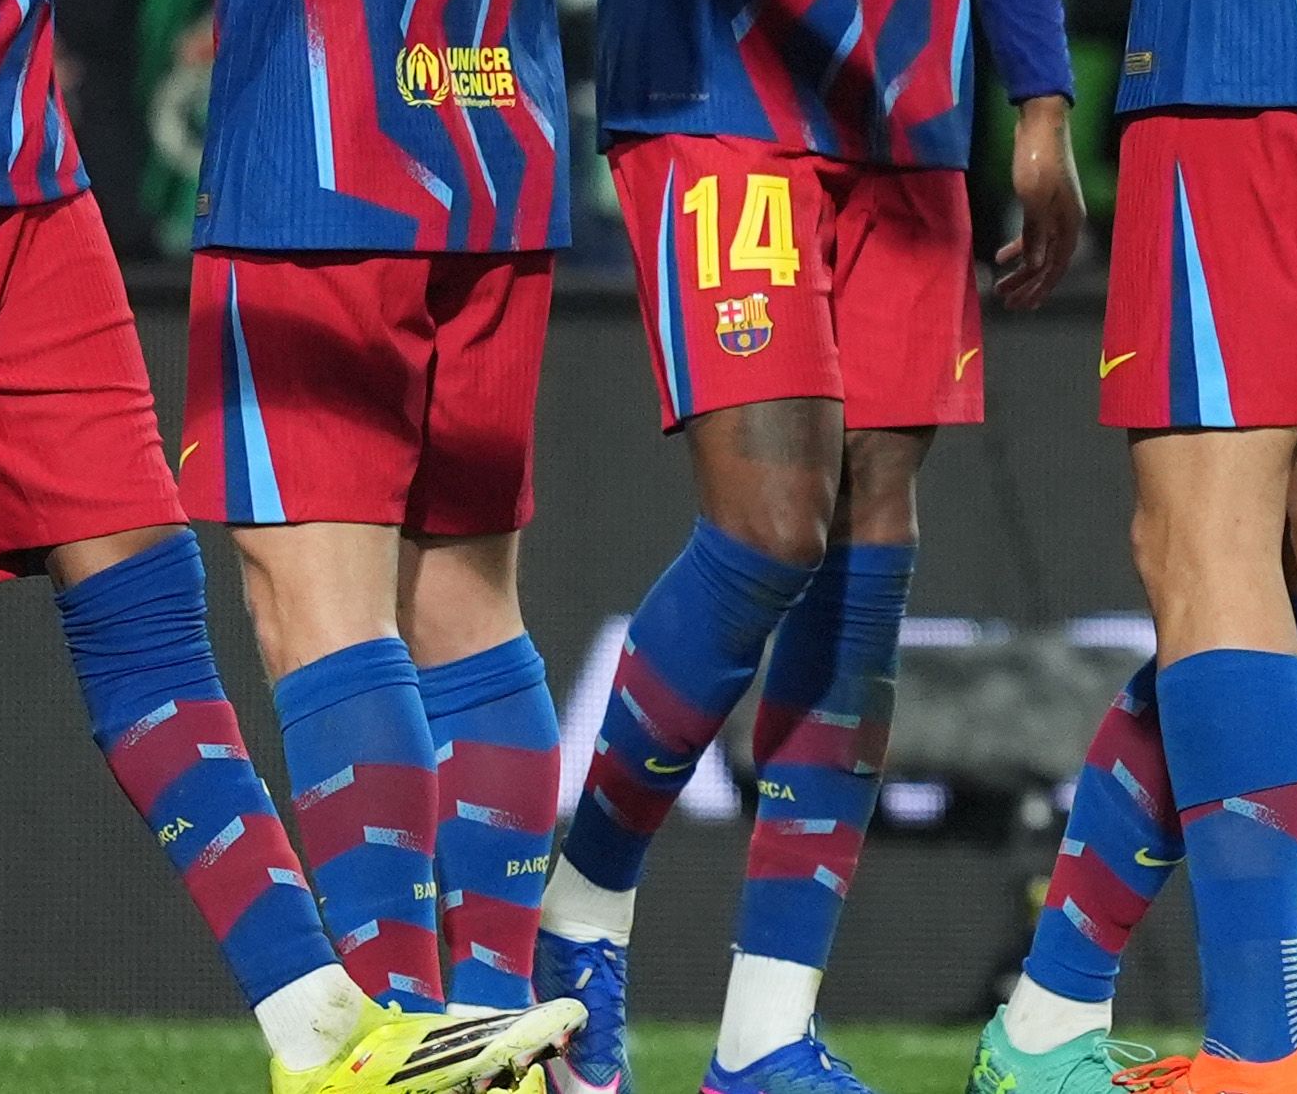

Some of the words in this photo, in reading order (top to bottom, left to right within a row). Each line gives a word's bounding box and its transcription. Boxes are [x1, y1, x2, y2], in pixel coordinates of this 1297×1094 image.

[446, 46, 512, 72] UNHCR
[450, 71, 515, 97] ACNUR
[683, 173, 800, 290] 14
